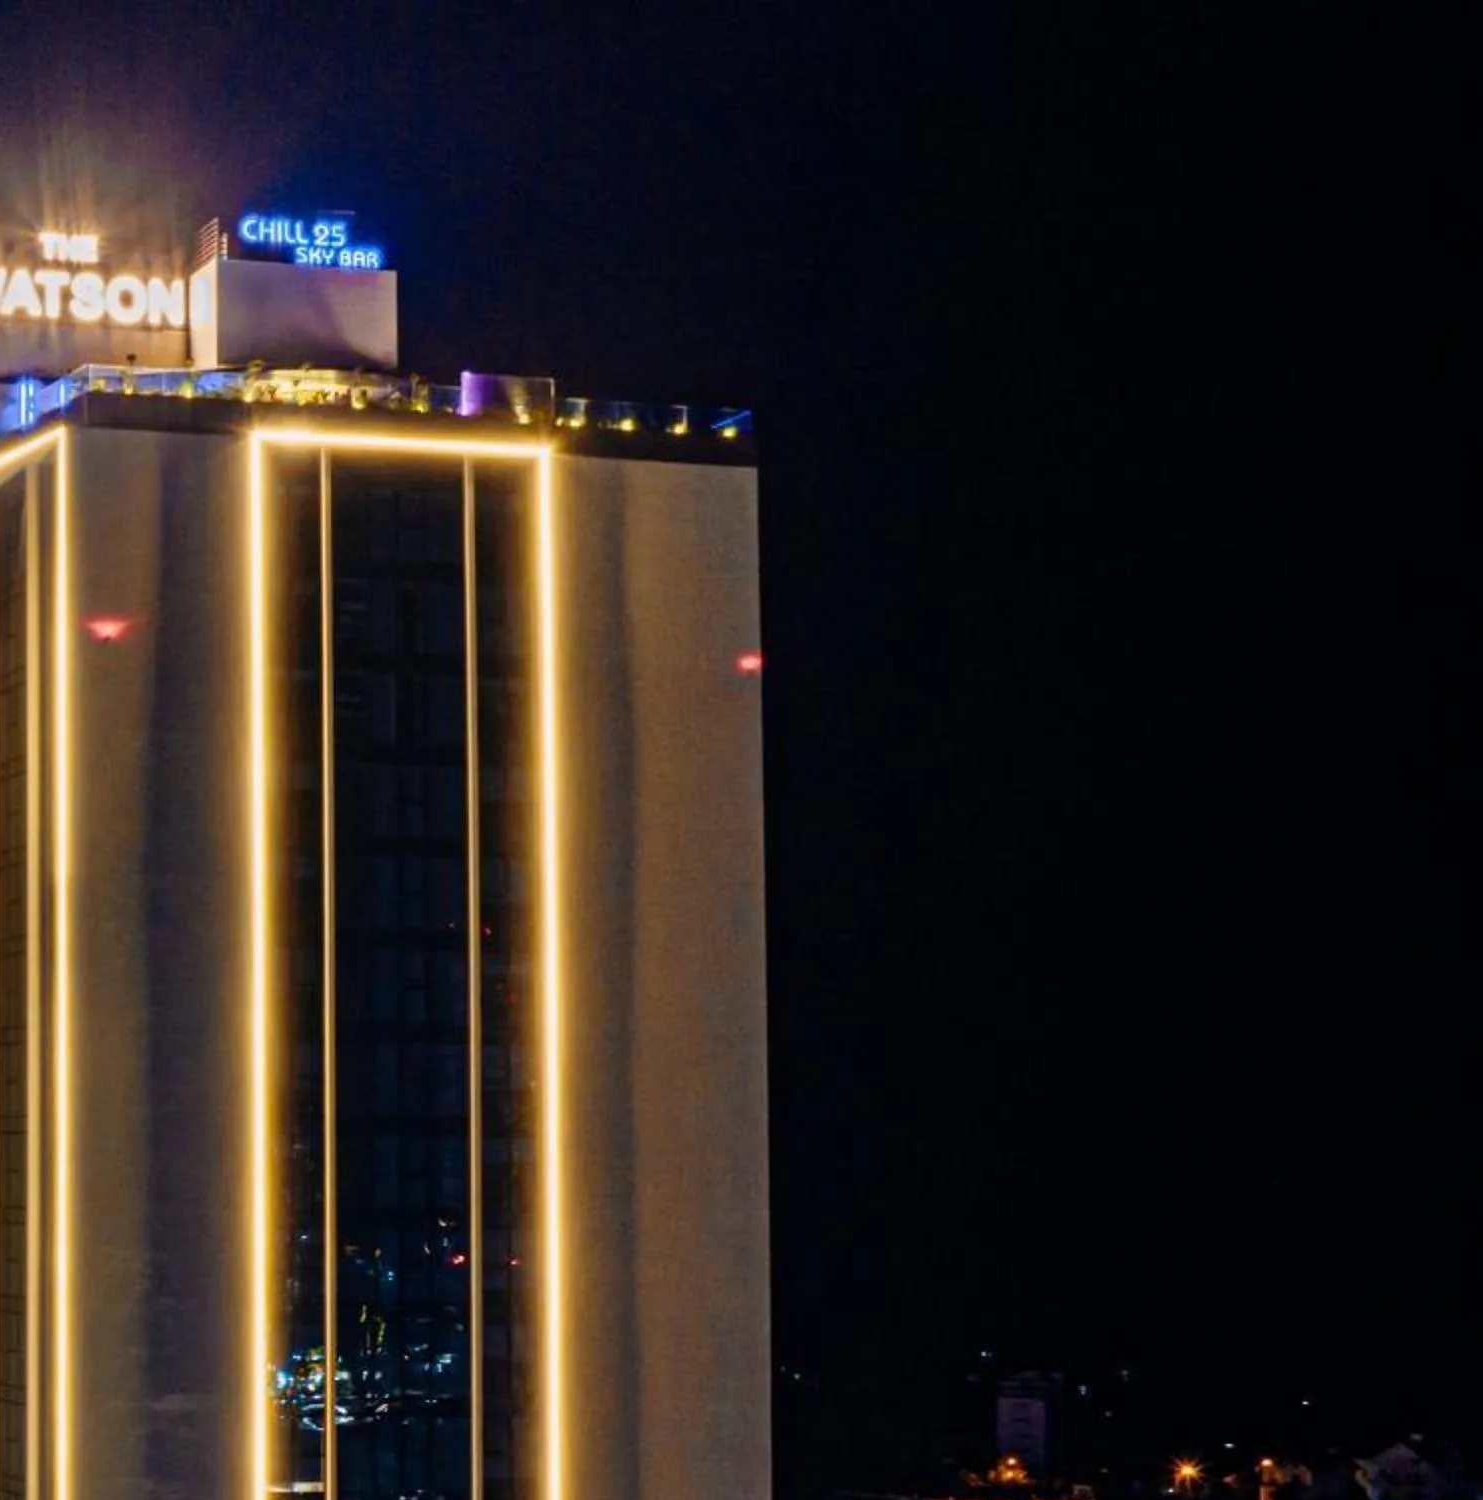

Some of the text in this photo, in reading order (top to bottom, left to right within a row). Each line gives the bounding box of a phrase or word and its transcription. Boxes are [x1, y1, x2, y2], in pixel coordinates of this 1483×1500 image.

[37, 231, 100, 263] THE
[241, 217, 346, 247] CHILL 25
[296, 247, 379, 269] SKY BAR
